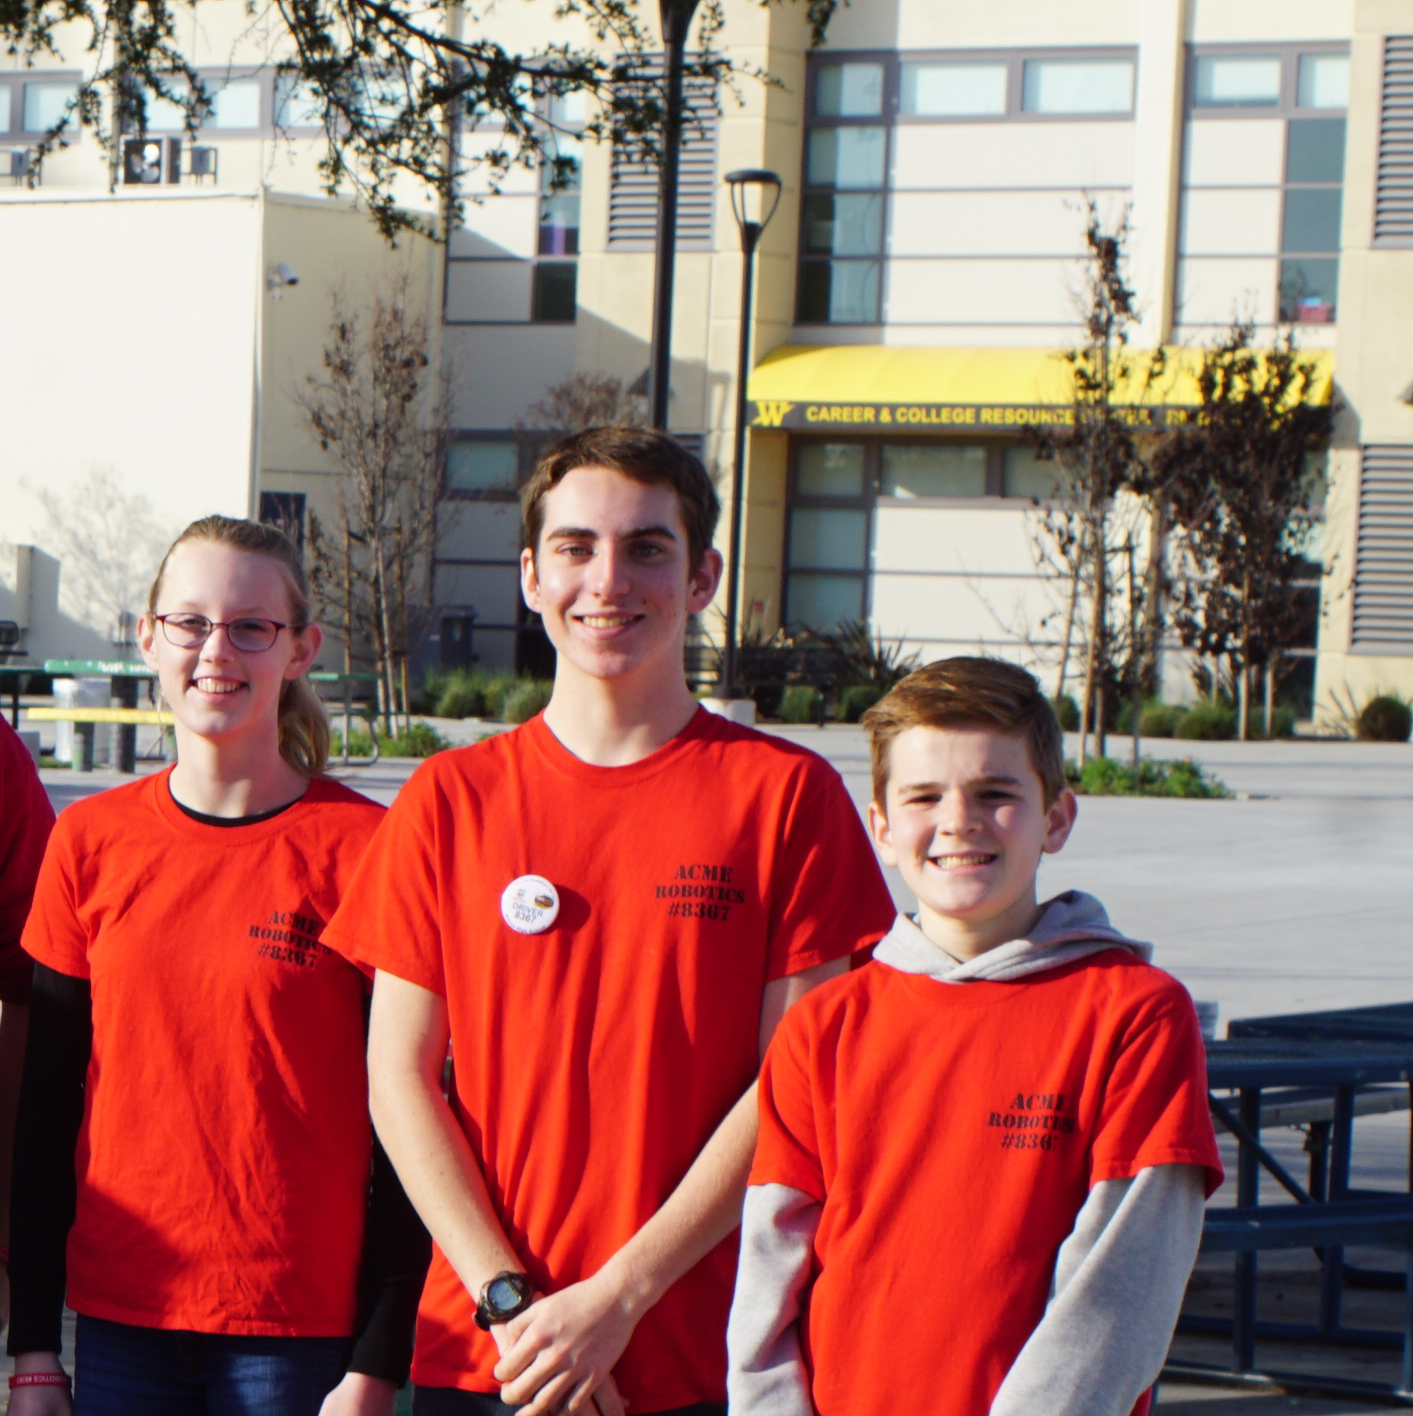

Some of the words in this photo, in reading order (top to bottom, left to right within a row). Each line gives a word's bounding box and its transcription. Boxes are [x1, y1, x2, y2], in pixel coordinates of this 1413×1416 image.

[806, 405, 875, 423] CAREER
[879, 406, 891, 423] &
[895, 406, 976, 424] COLLEGE
[980, 407, 1075, 425] RESOURCE
[674, 864, 733, 883] ACME
[654, 884, 746, 904] ROBOTICS
[512, 902, 544, 917] DRIVER
[514, 910, 536, 923] 8367
[667, 902, 731, 921] #8367
[268, 910, 320, 937] ACME
[258, 943, 317, 968] #8367
[1001, 1133, 1058, 1151] #836
